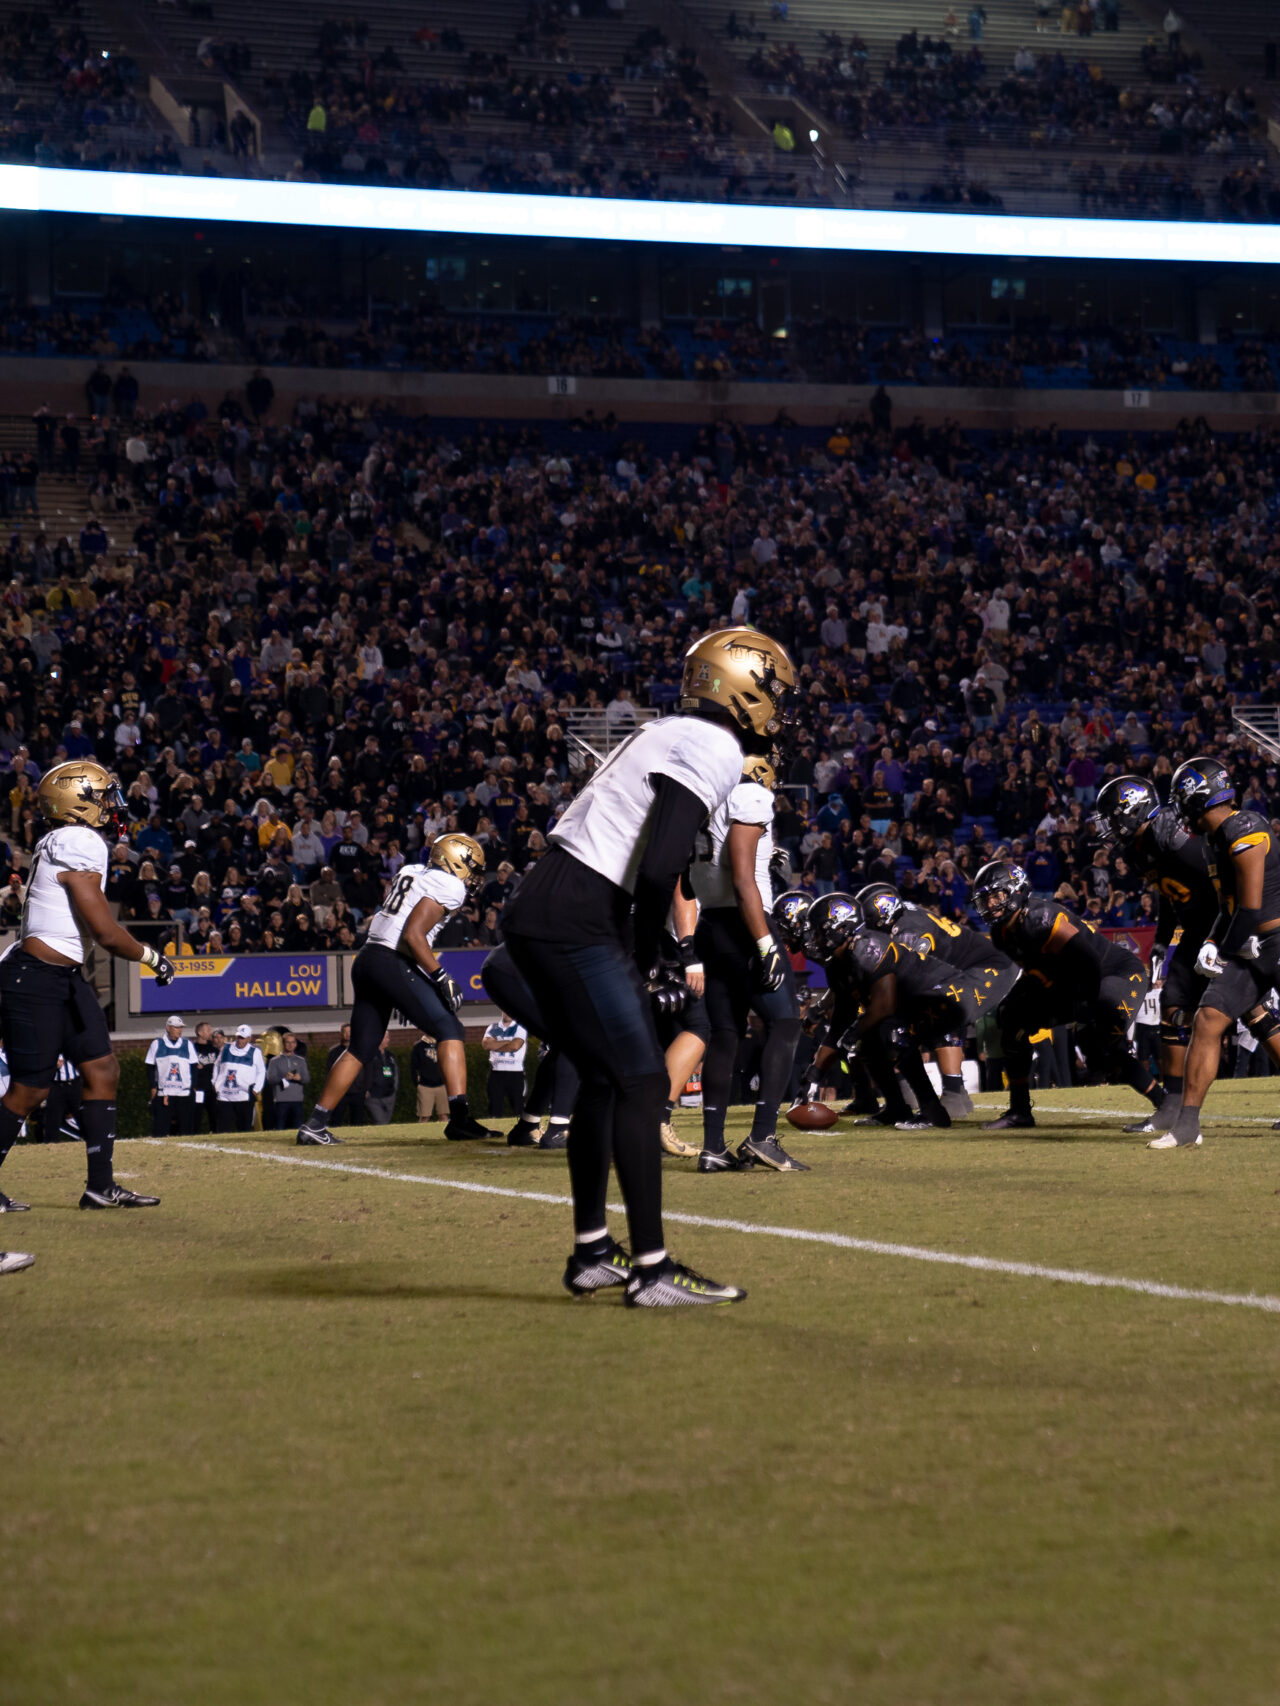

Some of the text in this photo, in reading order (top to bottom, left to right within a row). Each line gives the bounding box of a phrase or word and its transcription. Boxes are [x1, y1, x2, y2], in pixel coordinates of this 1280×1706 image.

[730, 647, 778, 670] UCF
[290, 965, 321, 977] LOU
[236, 980, 322, 998] HALLOW
[1144, 998, 1157, 1015] 14
